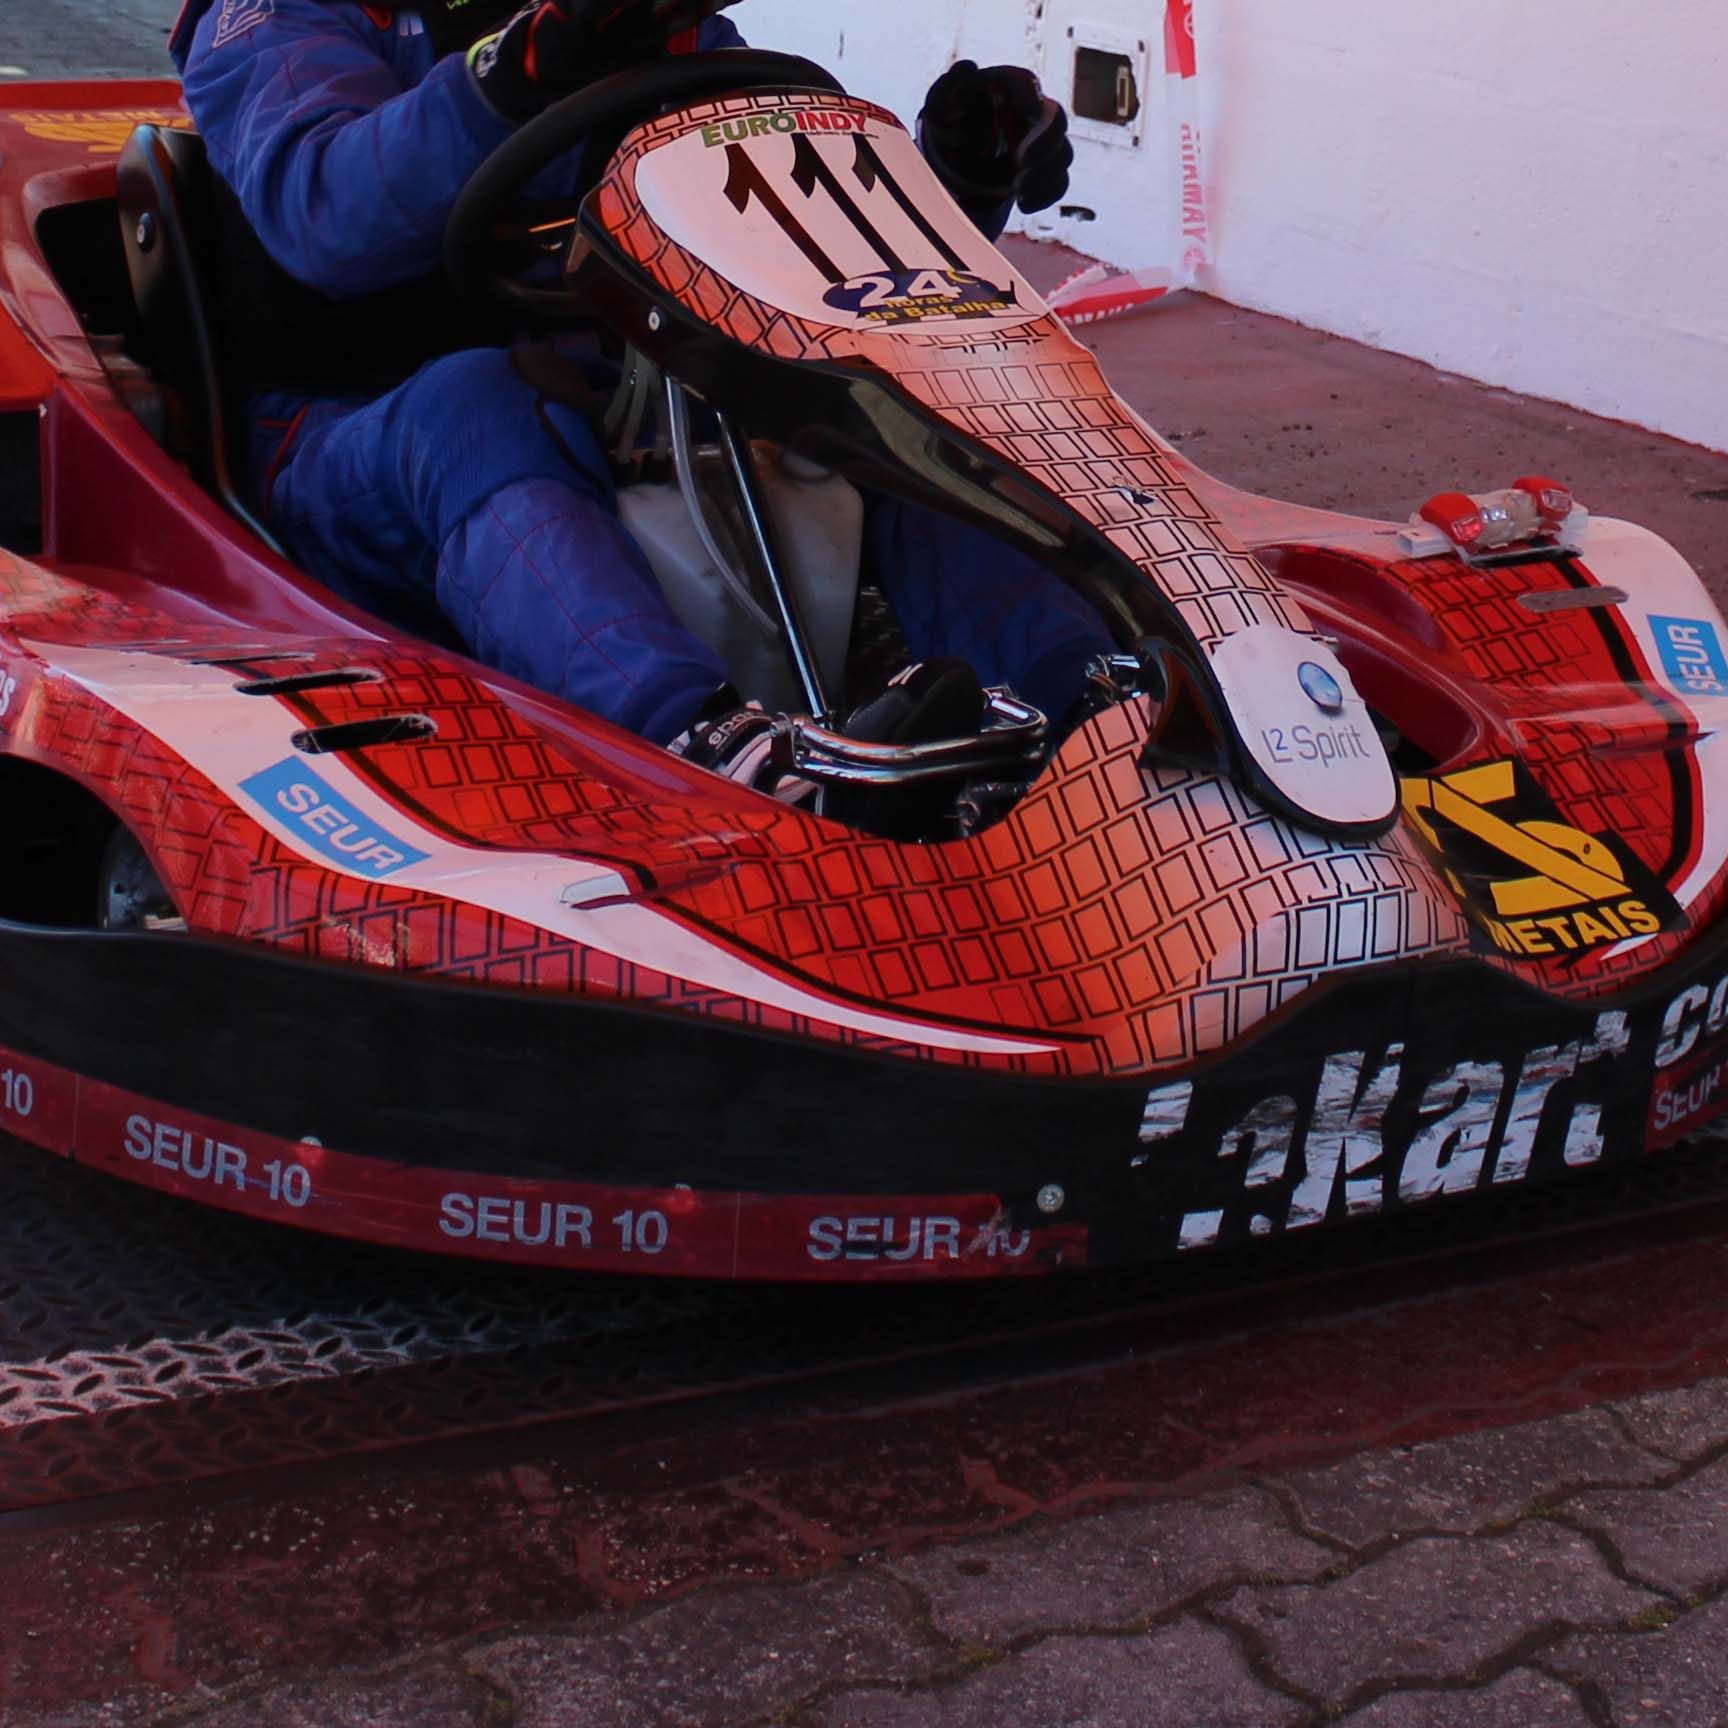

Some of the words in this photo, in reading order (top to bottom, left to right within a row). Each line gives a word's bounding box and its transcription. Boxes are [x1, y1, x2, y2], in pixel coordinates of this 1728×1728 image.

[723, 133, 972, 284] 111
[843, 271, 963, 309] 24
[904, 301, 1007, 318] Batalha
[1667, 624, 1724, 691] SEUR
[1291, 723, 1371, 769] Spirit
[275, 781, 406, 875] SEUR
[1478, 899, 1661, 955] METAIS
[0, 1068, 34, 1117] 10
[124, 1114, 248, 1194] SEUR
[261, 1159, 312, 1208] 10
[439, 1192, 593, 1248] SEUR
[612, 1208, 669, 1254] 10
[807, 1215, 961, 1260] SEUR
